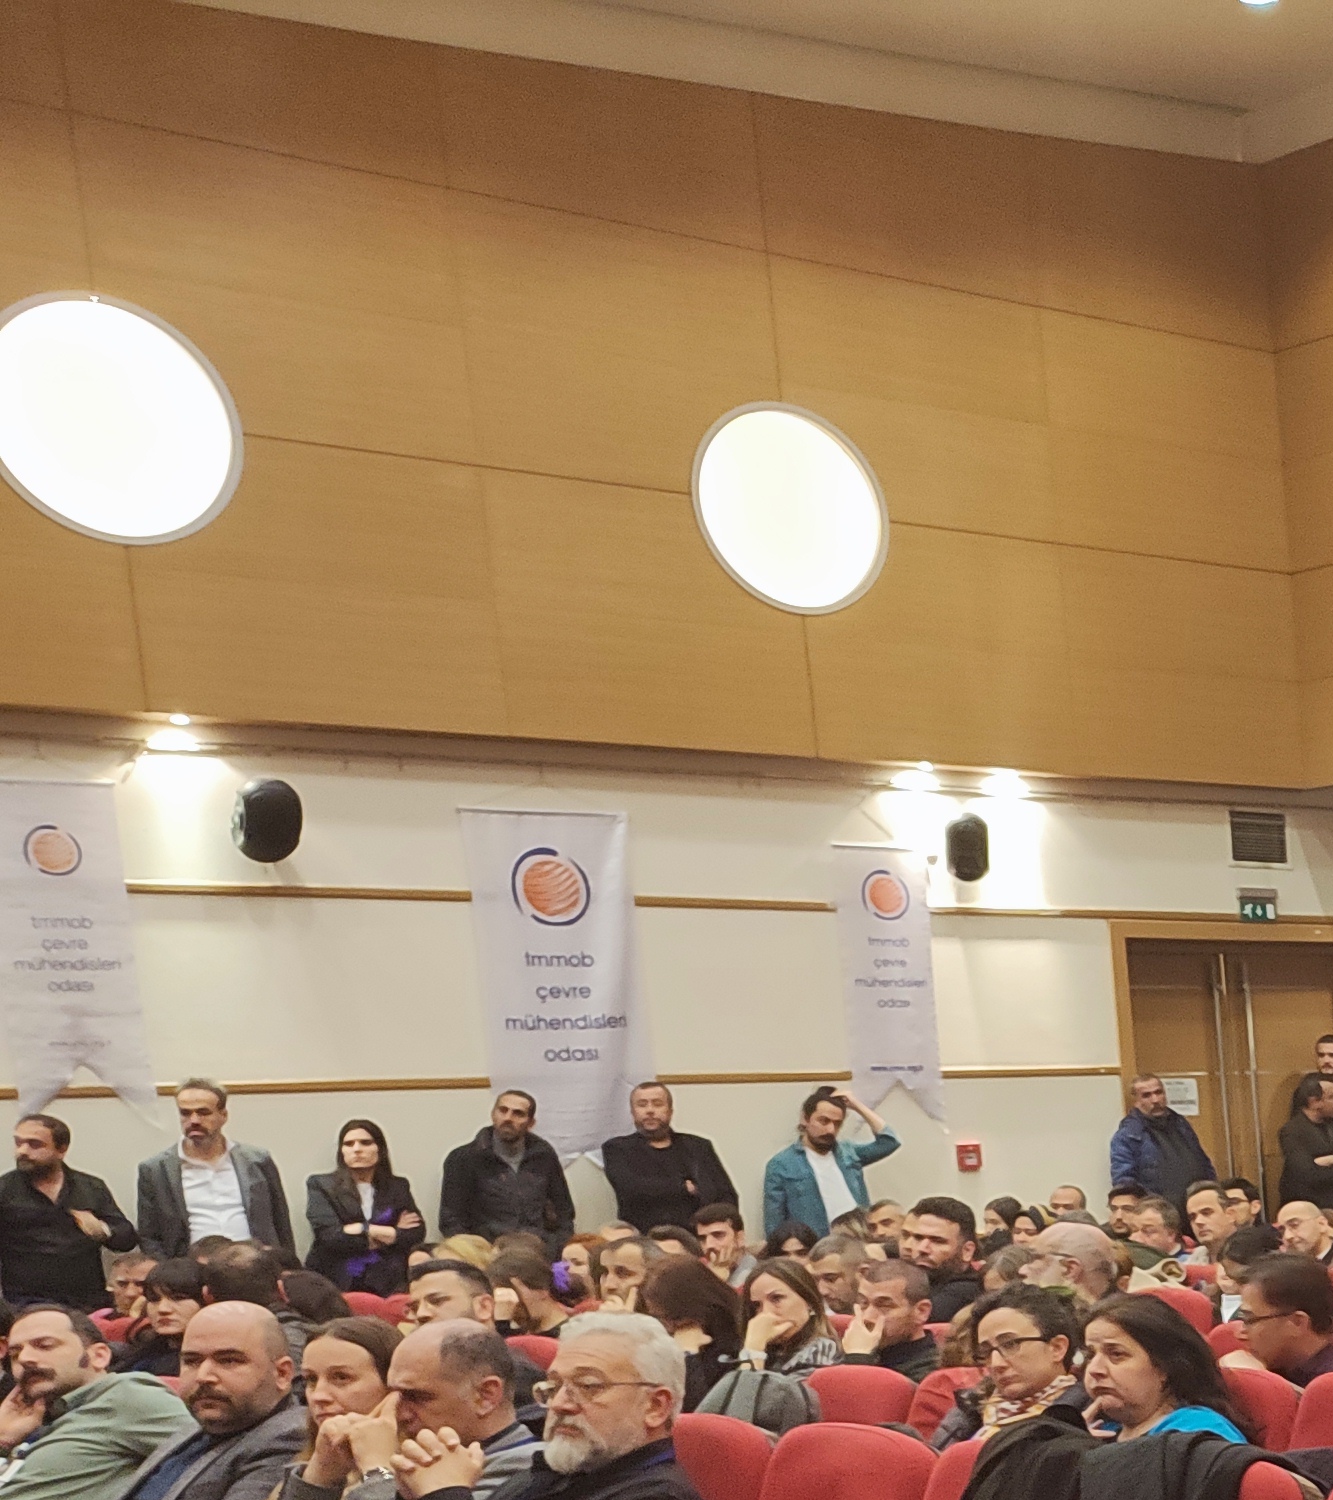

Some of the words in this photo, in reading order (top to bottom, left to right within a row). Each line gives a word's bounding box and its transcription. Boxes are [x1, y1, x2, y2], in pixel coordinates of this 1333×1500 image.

[31, 916, 93, 929] tmmob
[525, 951, 594, 967] tmmob
[536, 986, 591, 1003] çevre
[544, 1047, 599, 1062] odası
